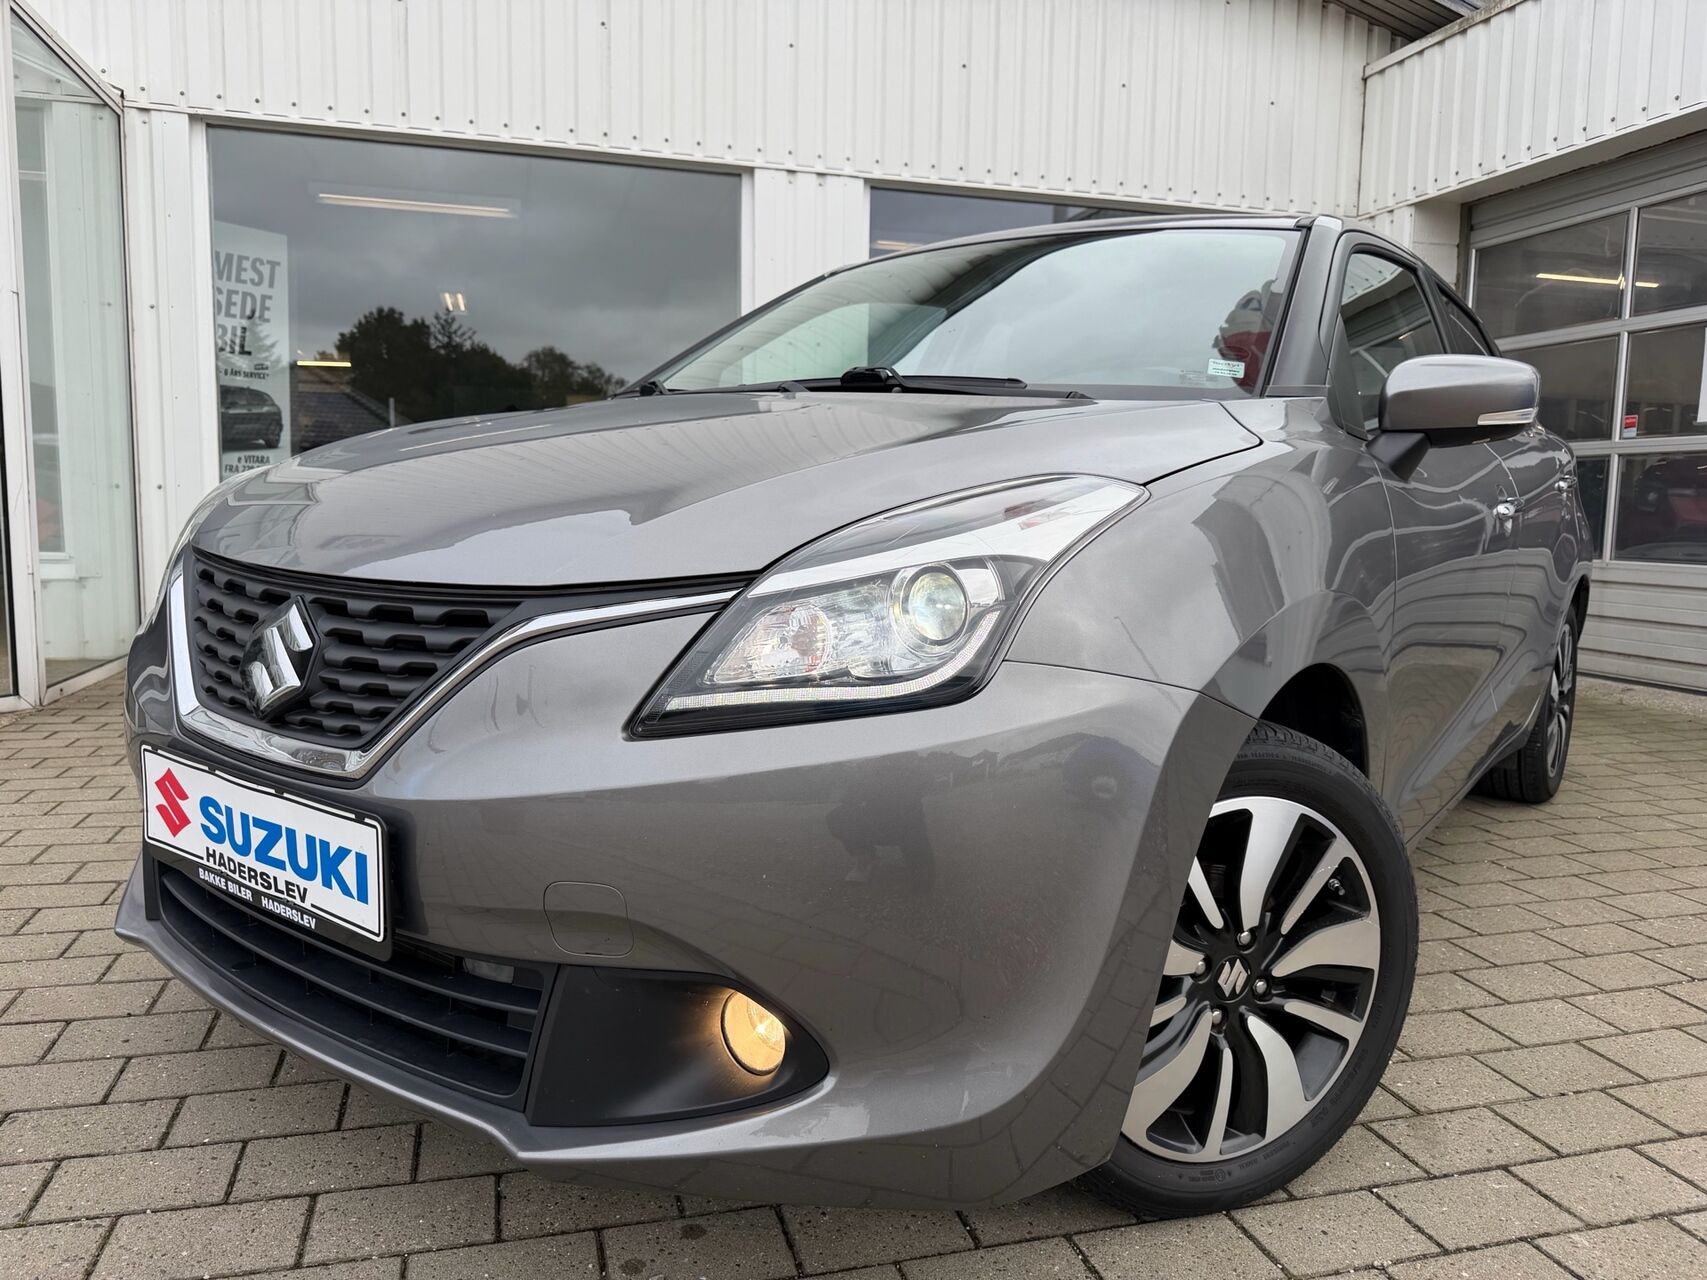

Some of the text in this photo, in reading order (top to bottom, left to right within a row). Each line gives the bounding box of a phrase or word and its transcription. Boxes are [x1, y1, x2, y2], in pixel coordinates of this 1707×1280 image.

[224, 464, 240, 474] FRA
[244, 454, 271, 465] VITARA
[199, 795, 369, 906] SUZUKI
[205, 846, 308, 904] HADERSLEV
[198, 867, 316, 930] BAKKE BILER HADERSLEV
